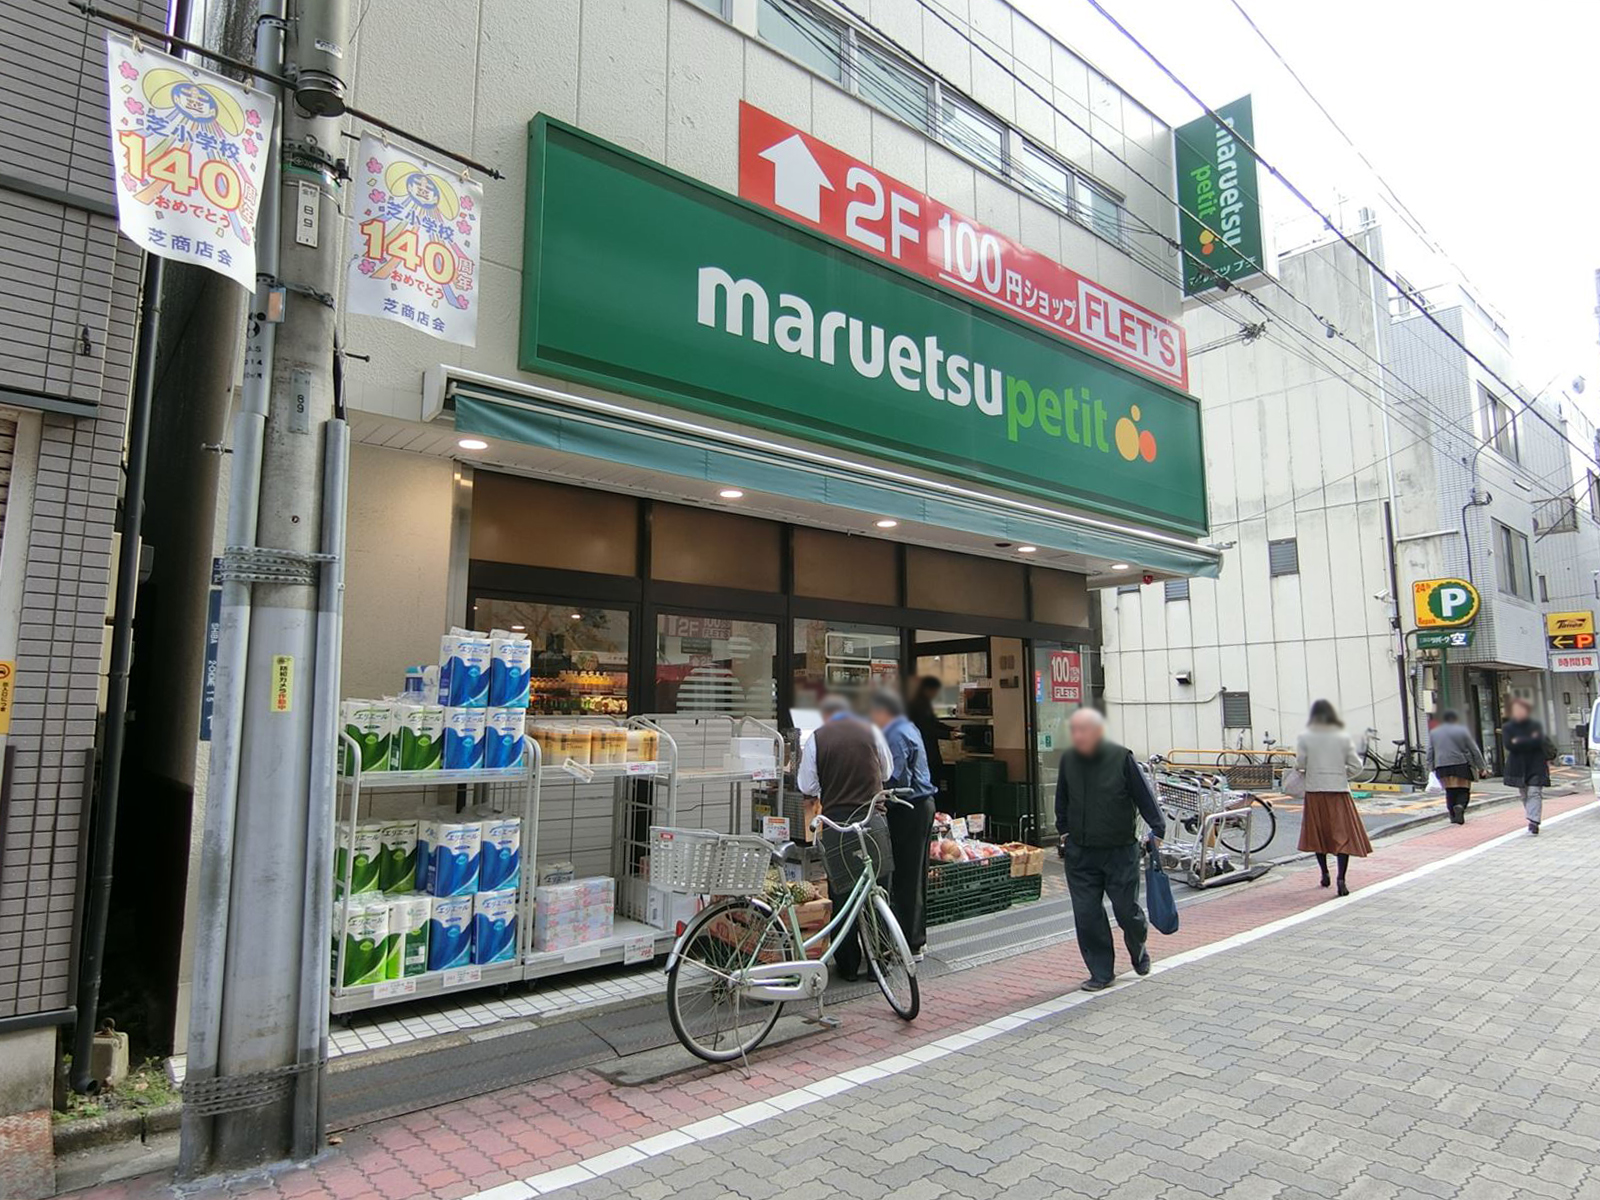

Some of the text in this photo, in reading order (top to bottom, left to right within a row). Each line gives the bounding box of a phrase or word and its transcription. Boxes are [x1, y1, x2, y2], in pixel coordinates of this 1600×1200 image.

[146, 112, 240, 162] 芝小学校
[119, 131, 243, 213] 140
[1190, 164, 1218, 220] petit
[154, 195, 231, 229] おめでとう
[387, 201, 455, 243] 芝小学校
[845, 166, 921, 260] 2F
[148, 227, 233, 268] 芝商店会
[361, 219, 455, 285] 140
[391, 269, 445, 301] おめでとう
[383, 298, 446, 333] 芝商店会
[1085, 292, 1176, 368] FLET'S
[697, 267, 1110, 454] maruetsu petit
[1440, 588, 1467, 617] P
[1450, 633, 1467, 646] 空
[1576, 634, 1593, 649] P
[1052, 657, 1069, 682] 100
